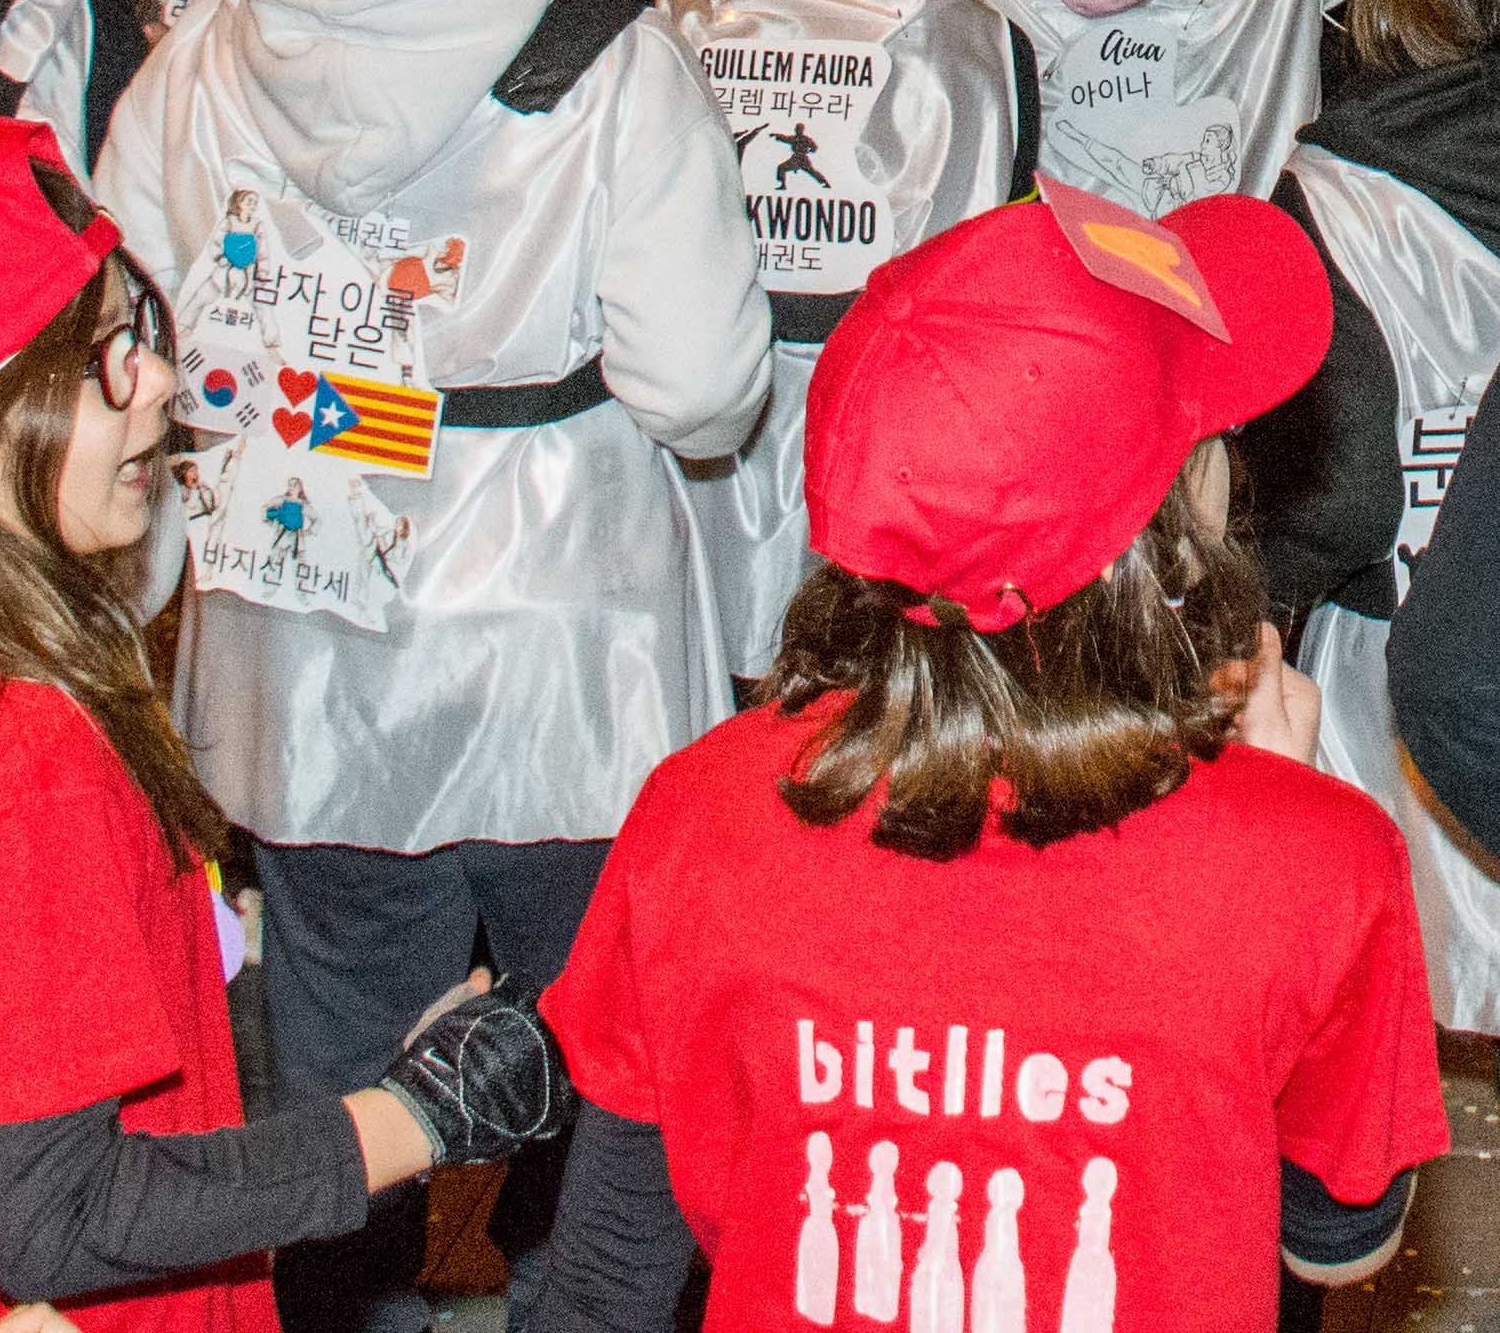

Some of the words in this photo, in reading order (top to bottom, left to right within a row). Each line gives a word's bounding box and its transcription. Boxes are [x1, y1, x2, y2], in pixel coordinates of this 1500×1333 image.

[1100, 29, 1166, 65] Aina
[700, 48, 794, 83] GUILLEM
[800, 53, 873, 87] FAURA
[771, 90, 853, 121] 파우라
[1071, 71, 1152, 108] 아이나
[337, 218, 409, 251] 태권도
[252, 264, 327, 315] 남자
[341, 282, 415, 332] 이름
[202, 540, 286, 587] 바지선
[295, 563, 350, 603] 만세
[797, 1018, 1133, 1125] bitlles
